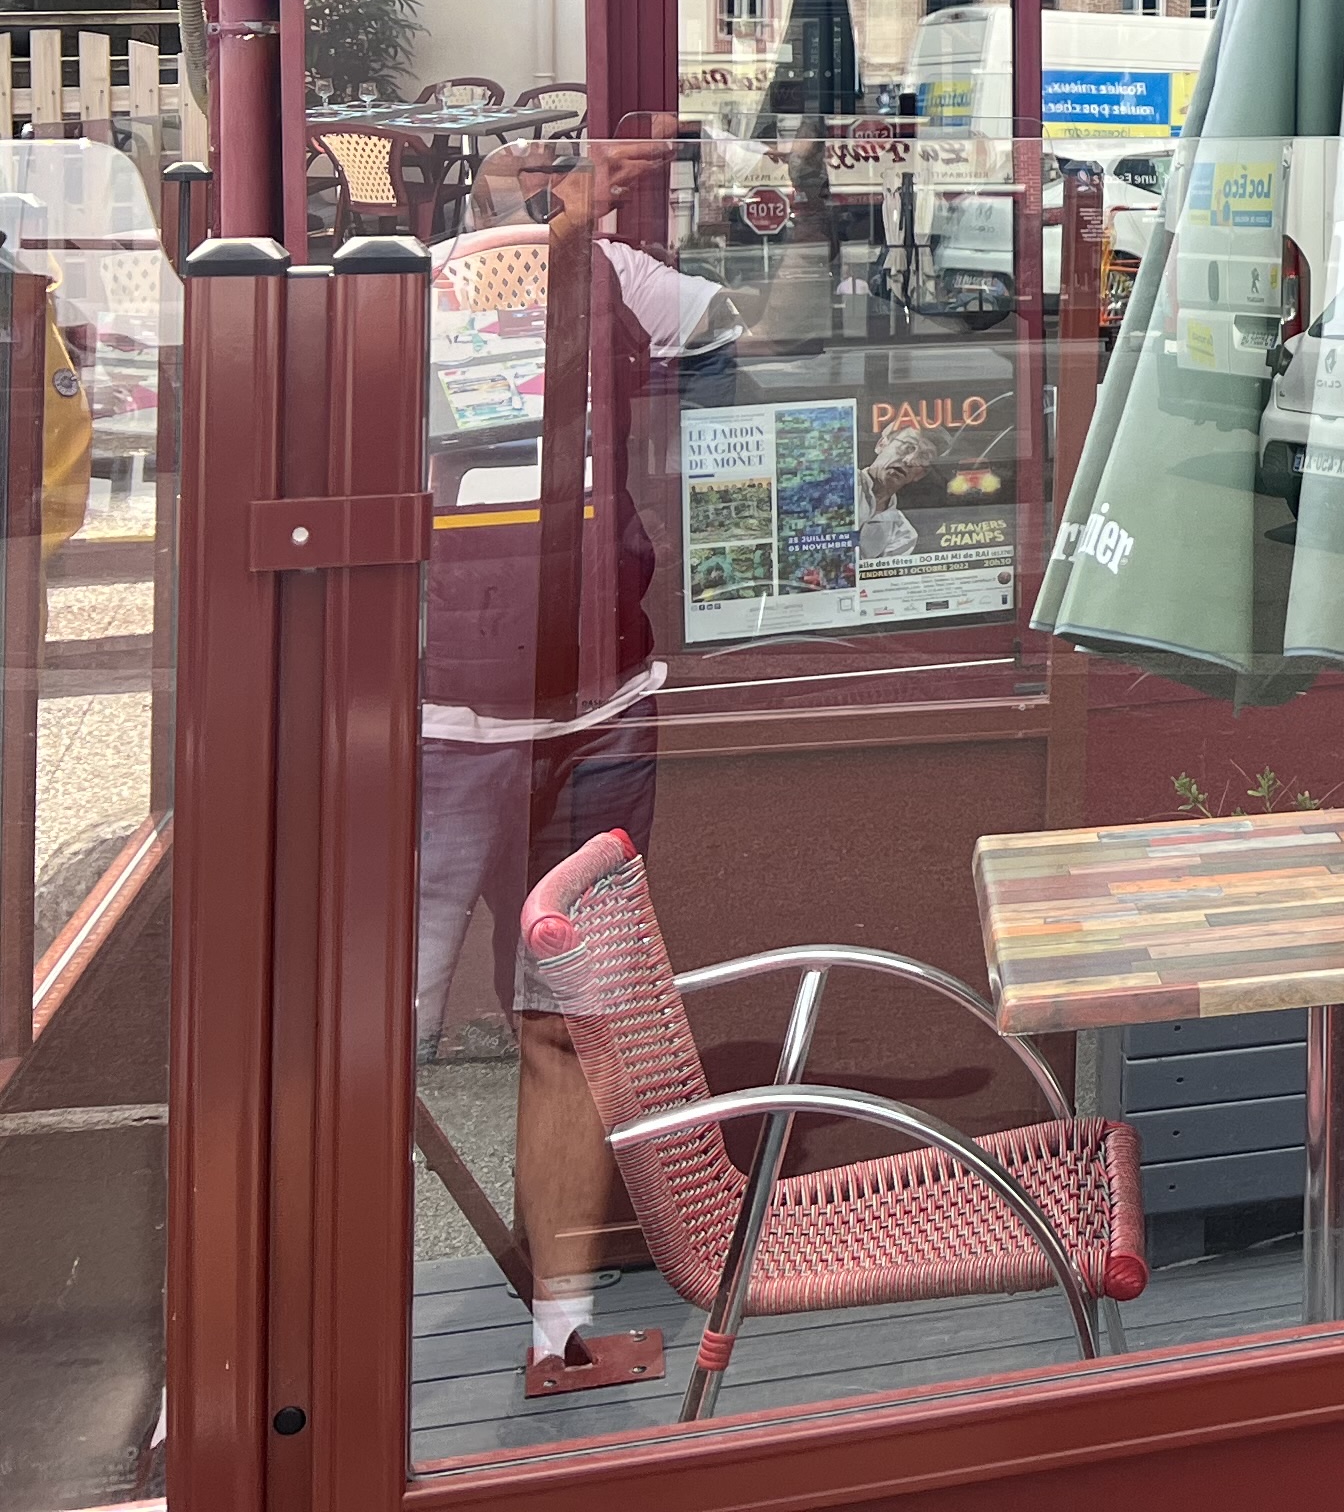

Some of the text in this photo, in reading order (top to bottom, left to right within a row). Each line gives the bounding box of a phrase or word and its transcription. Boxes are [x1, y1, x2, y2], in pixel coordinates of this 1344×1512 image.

[871, 395, 988, 434] PAULO
[687, 425, 765, 443] LE JARDIN
[687, 439, 766, 458] MAGIQUE
[688, 453, 766, 472] DE MONET
[949, 519, 1008, 534] TRAVERS
[800, 533, 837, 544] JUILLET
[801, 539, 854, 552] NOVEMBRE
[939, 530, 1006, 547] CHAMPS
[858, 559, 875, 569] alle
[910, 564, 949, 574] OCTOBRE
[983, 557, 1012, 568] 20h30
